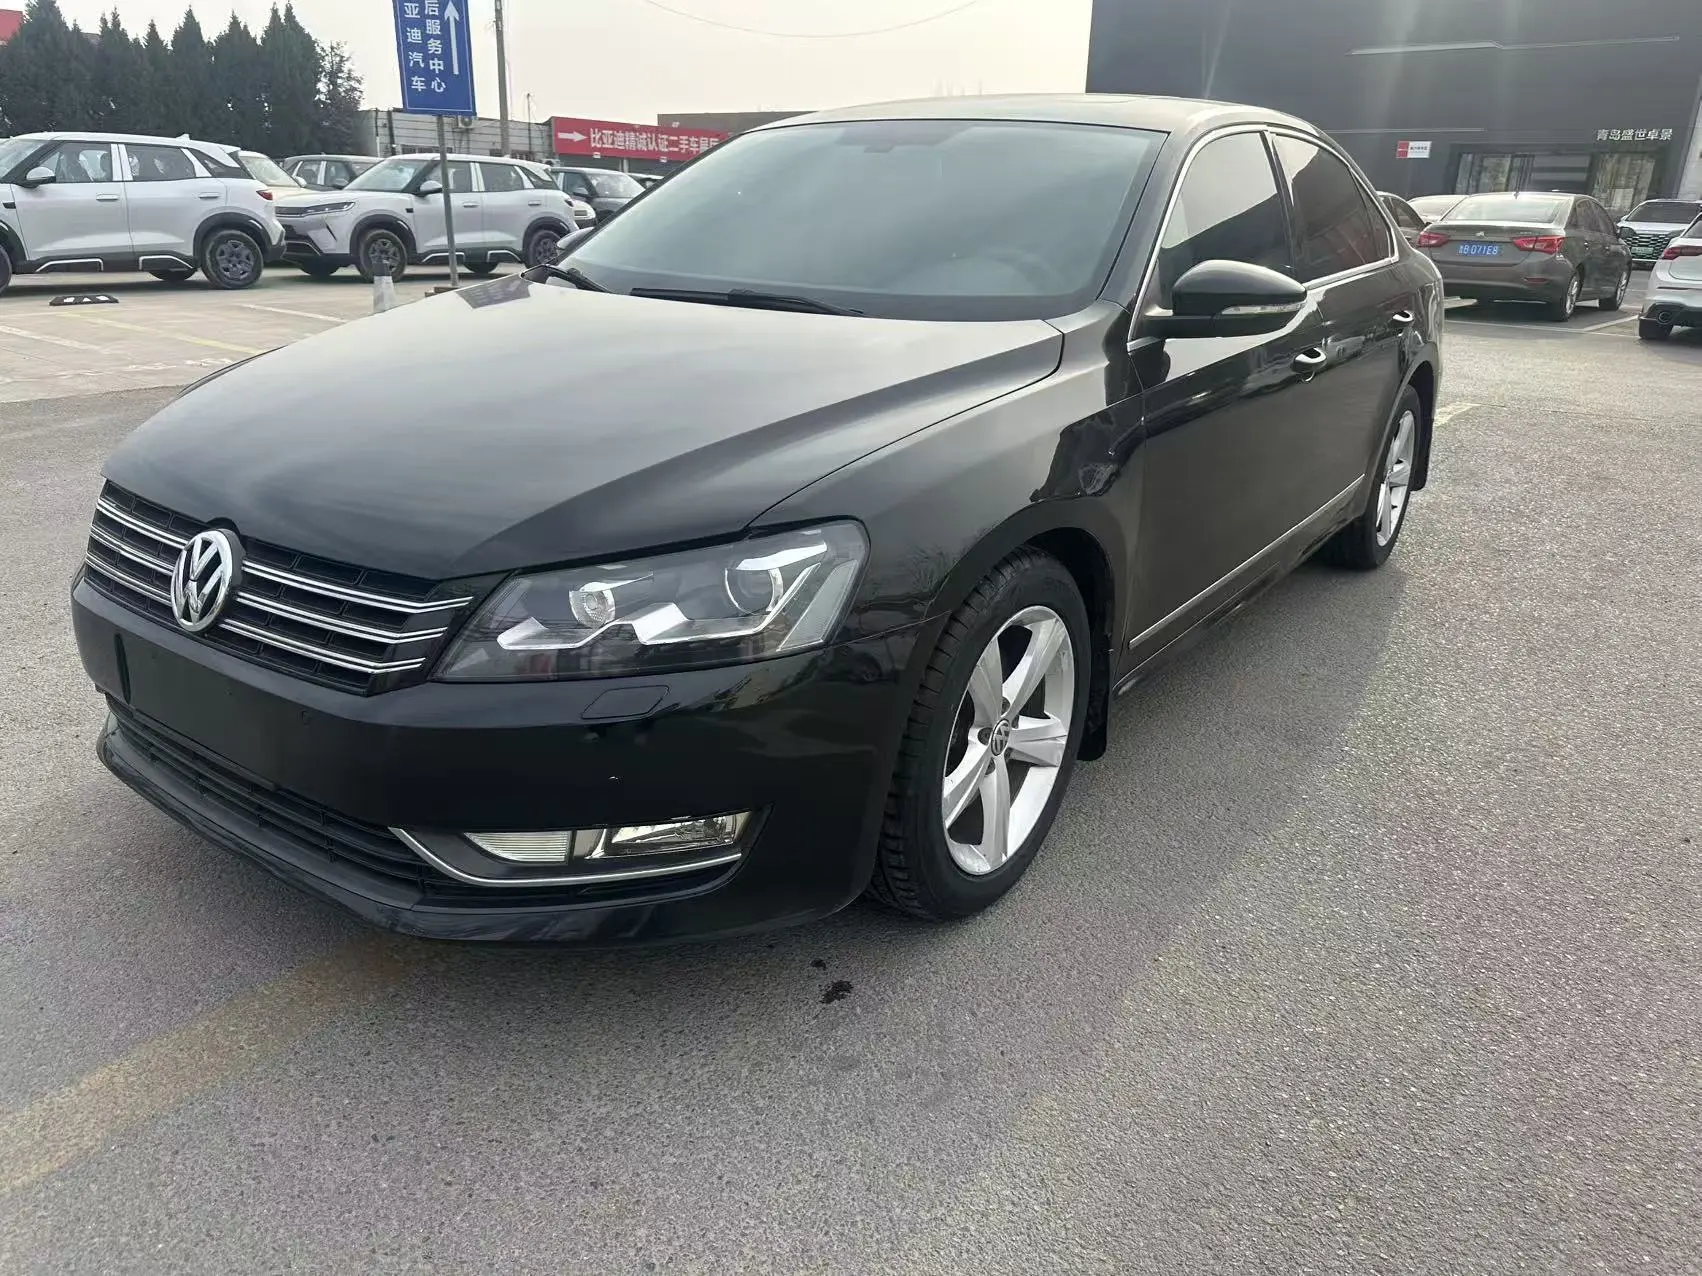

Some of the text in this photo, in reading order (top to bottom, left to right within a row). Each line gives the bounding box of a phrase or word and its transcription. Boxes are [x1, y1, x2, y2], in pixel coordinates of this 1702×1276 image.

[403, 2, 427, 92] 亚迪汽车
[1597, 128, 1673, 141] 青岛盛世卓景
